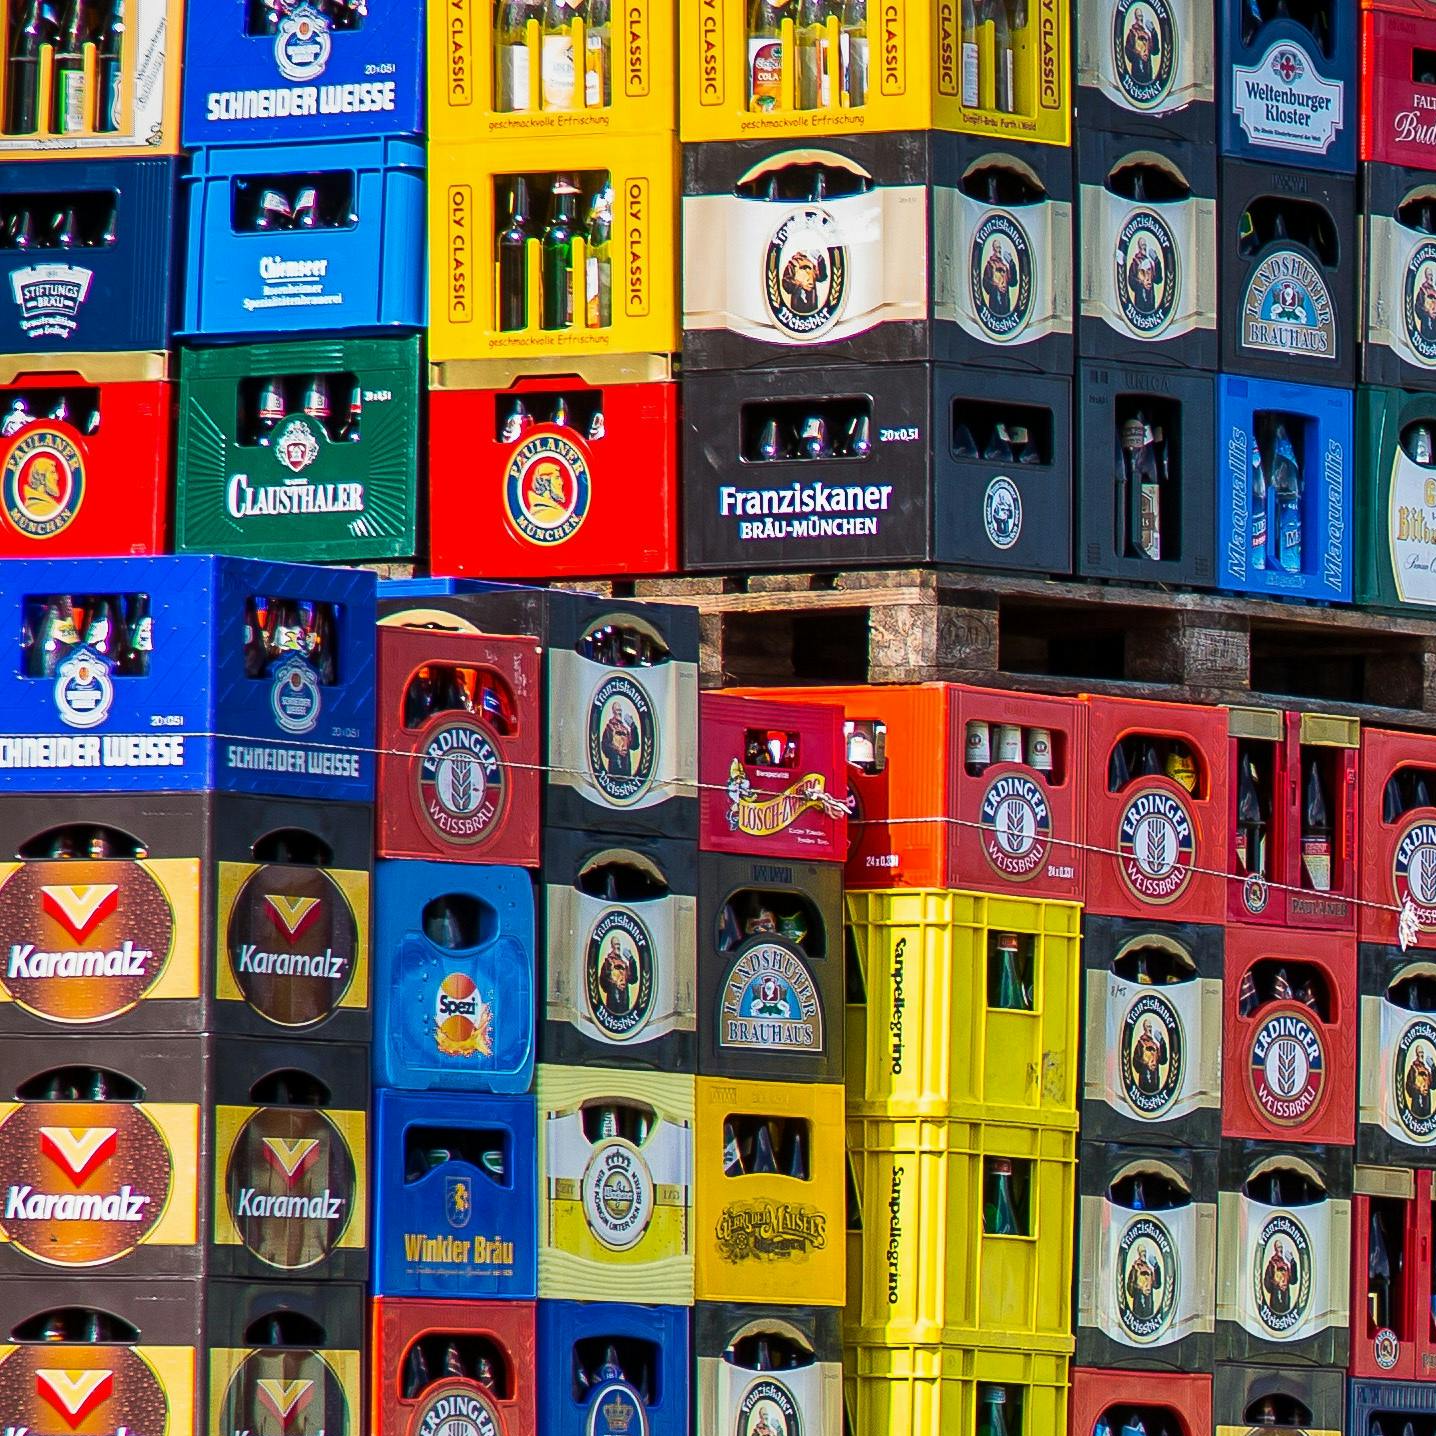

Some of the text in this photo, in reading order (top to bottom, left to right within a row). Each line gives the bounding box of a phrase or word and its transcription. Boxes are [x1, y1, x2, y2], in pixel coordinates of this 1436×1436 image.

[207, 80, 395, 121] SCHNEIDER WEISSE
[1245, 80, 1332, 114] Weltenburger
[740, 113, 865, 133] geschmackvolle Erfrischung
[1265, 103, 1311, 128] Kloster
[453, 190, 465, 312] OLY CLASSIC
[22, 283, 79, 299] STIFTUNGS
[37, 296, 65, 308] BRÄU
[489, 334, 609, 349] geschmackvolle Erfrischung
[508, 435, 586, 477] PAULANER
[228, 474, 363, 519] CLAUSTHALER
[720, 482, 892, 516] Franziskaner
[1224, 426, 1247, 583] Maquallis
[741, 516, 877, 540] BRÄU-MÜNCHEN
[227, 745, 359, 778] SCHNEIDER WEISSE
[424, 727, 498, 773] ERDINGER
[1118, 795, 1190, 842] ERDINGER
[8, 942, 153, 980] Karamalz
[439, 994, 476, 1018] Spezi
[890, 936, 907, 1076] Sanpellegrino
[404, 1233, 514, 1264] Winkler Bräu
